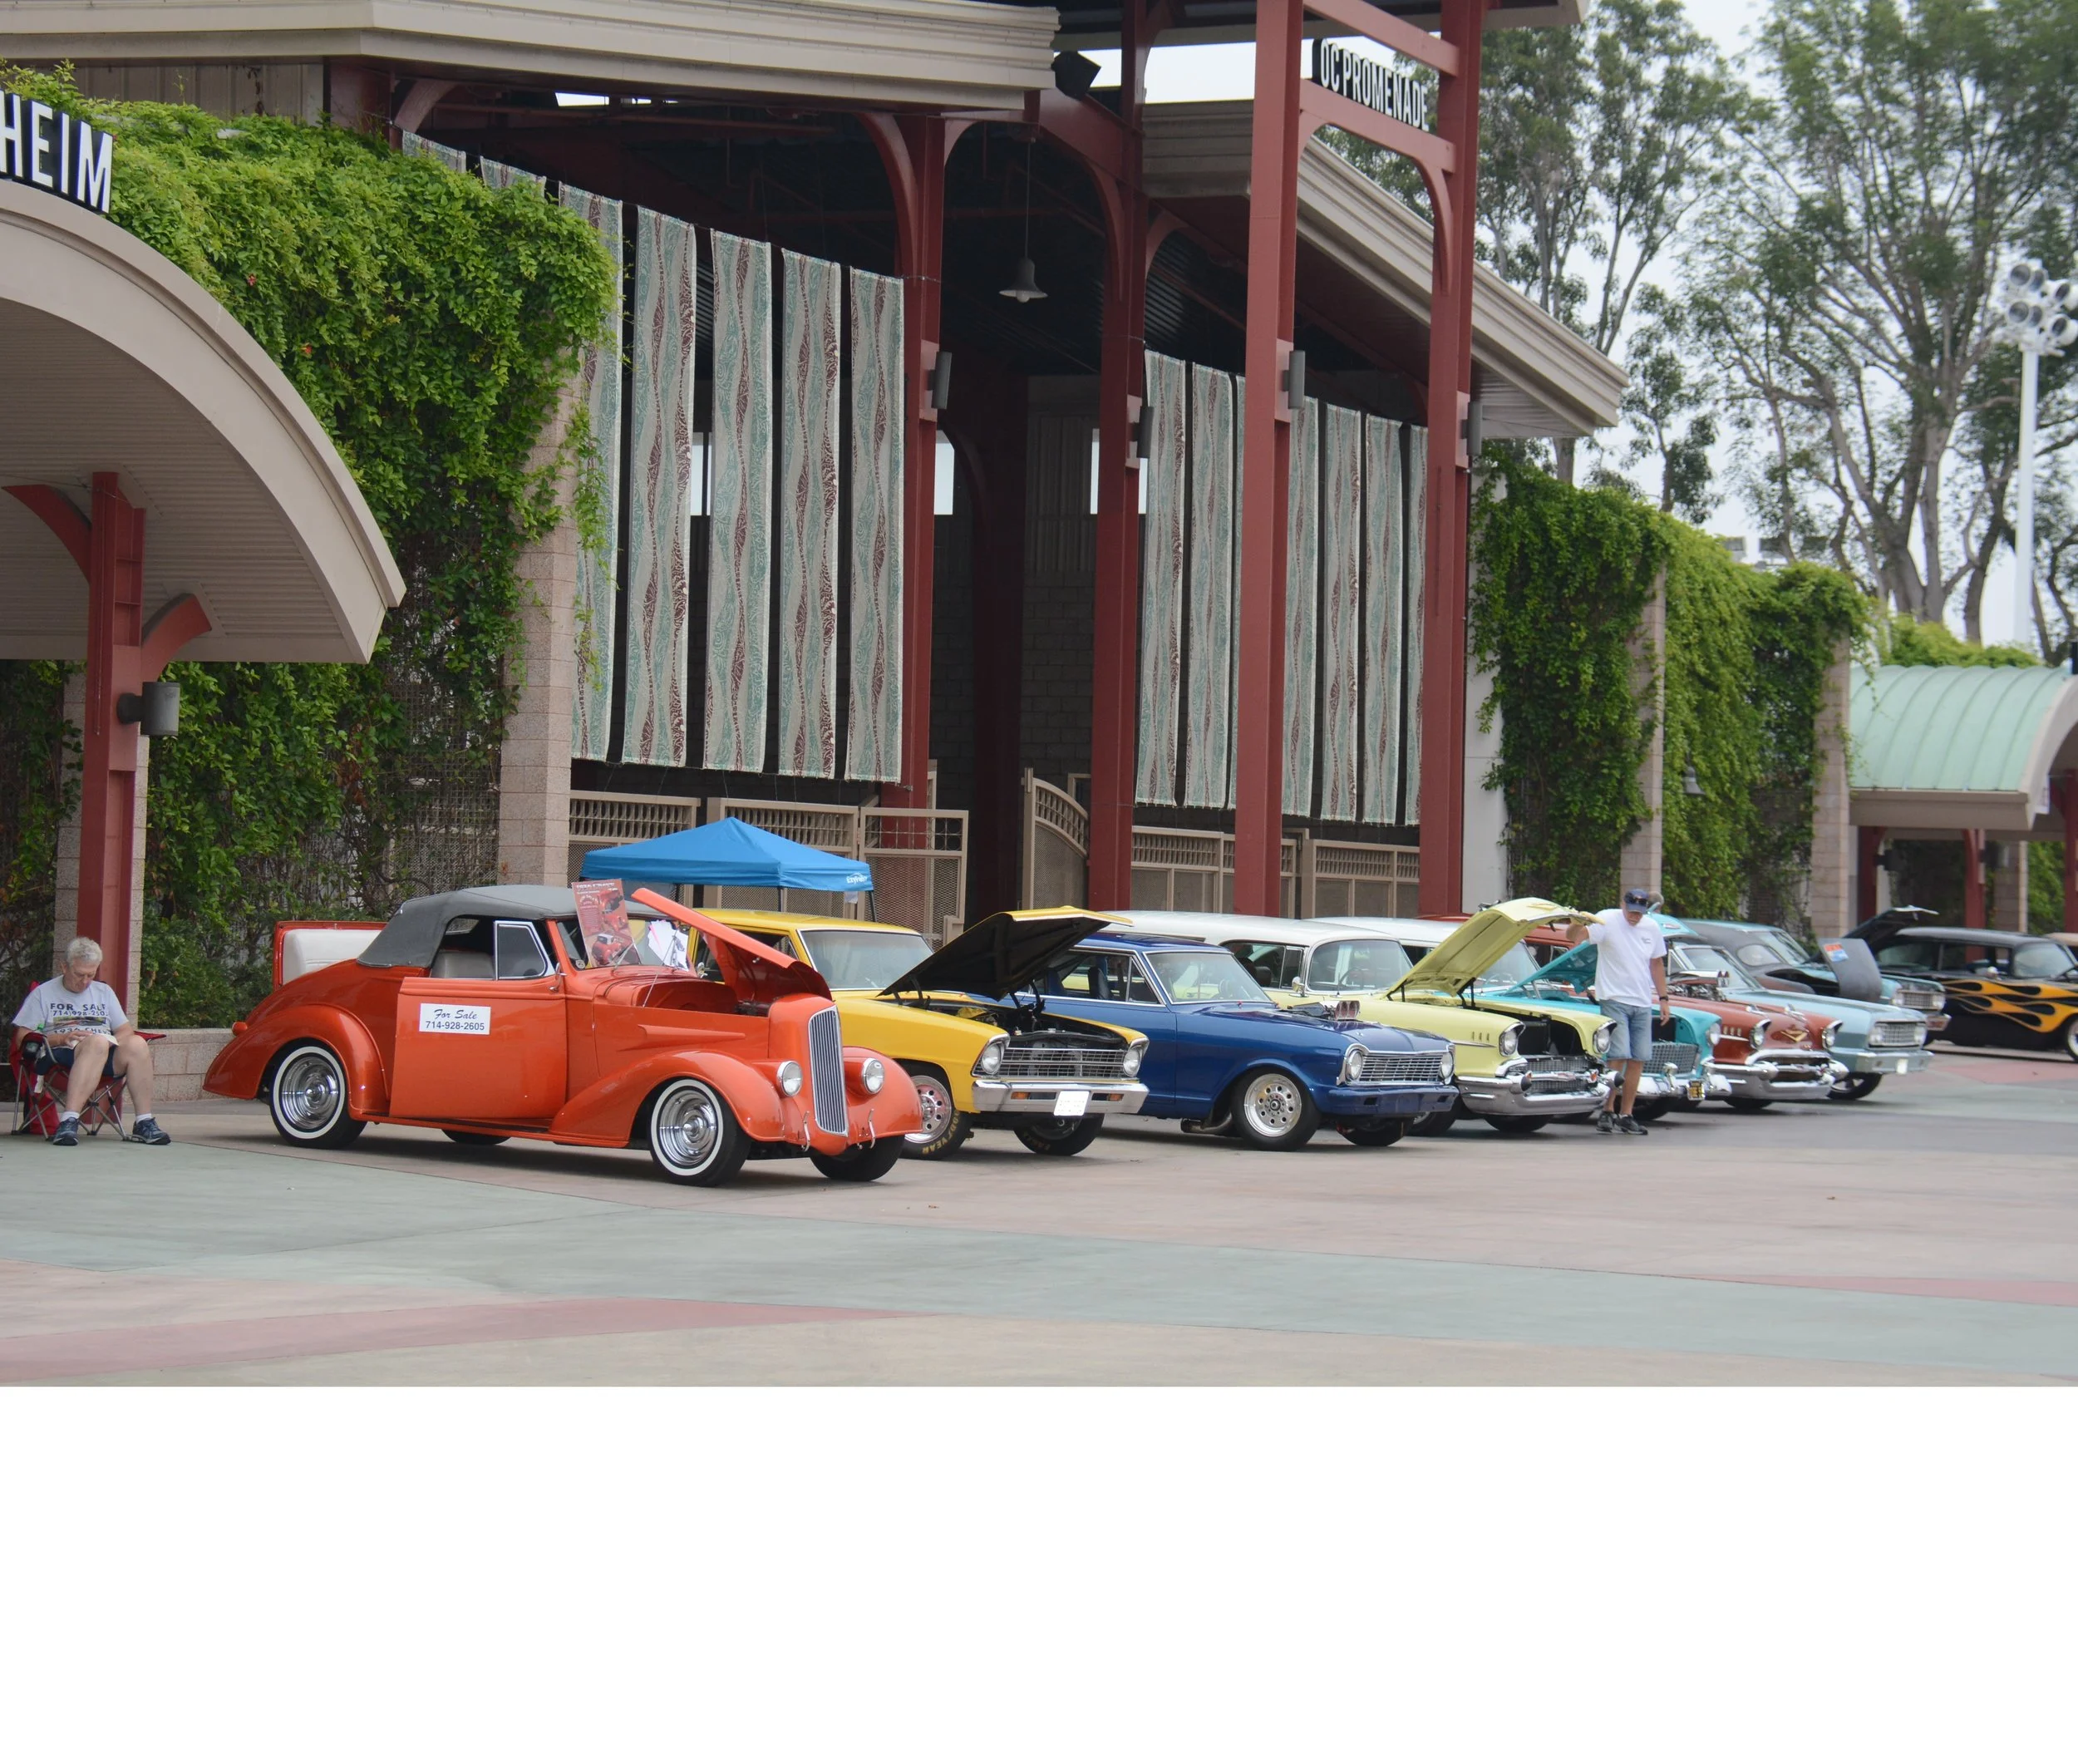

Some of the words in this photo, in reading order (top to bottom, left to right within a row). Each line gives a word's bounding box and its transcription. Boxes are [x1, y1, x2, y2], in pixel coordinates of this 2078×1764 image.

[1320, 38, 1340, 92] OC
[1342, 48, 1430, 132] PROMENADE
[50, 1003, 74, 1011] FOR
[434, 1008, 451, 1019] For
[455, 1009, 478, 1019] Sale
[426, 1021, 485, 1031] 714-928-2605
